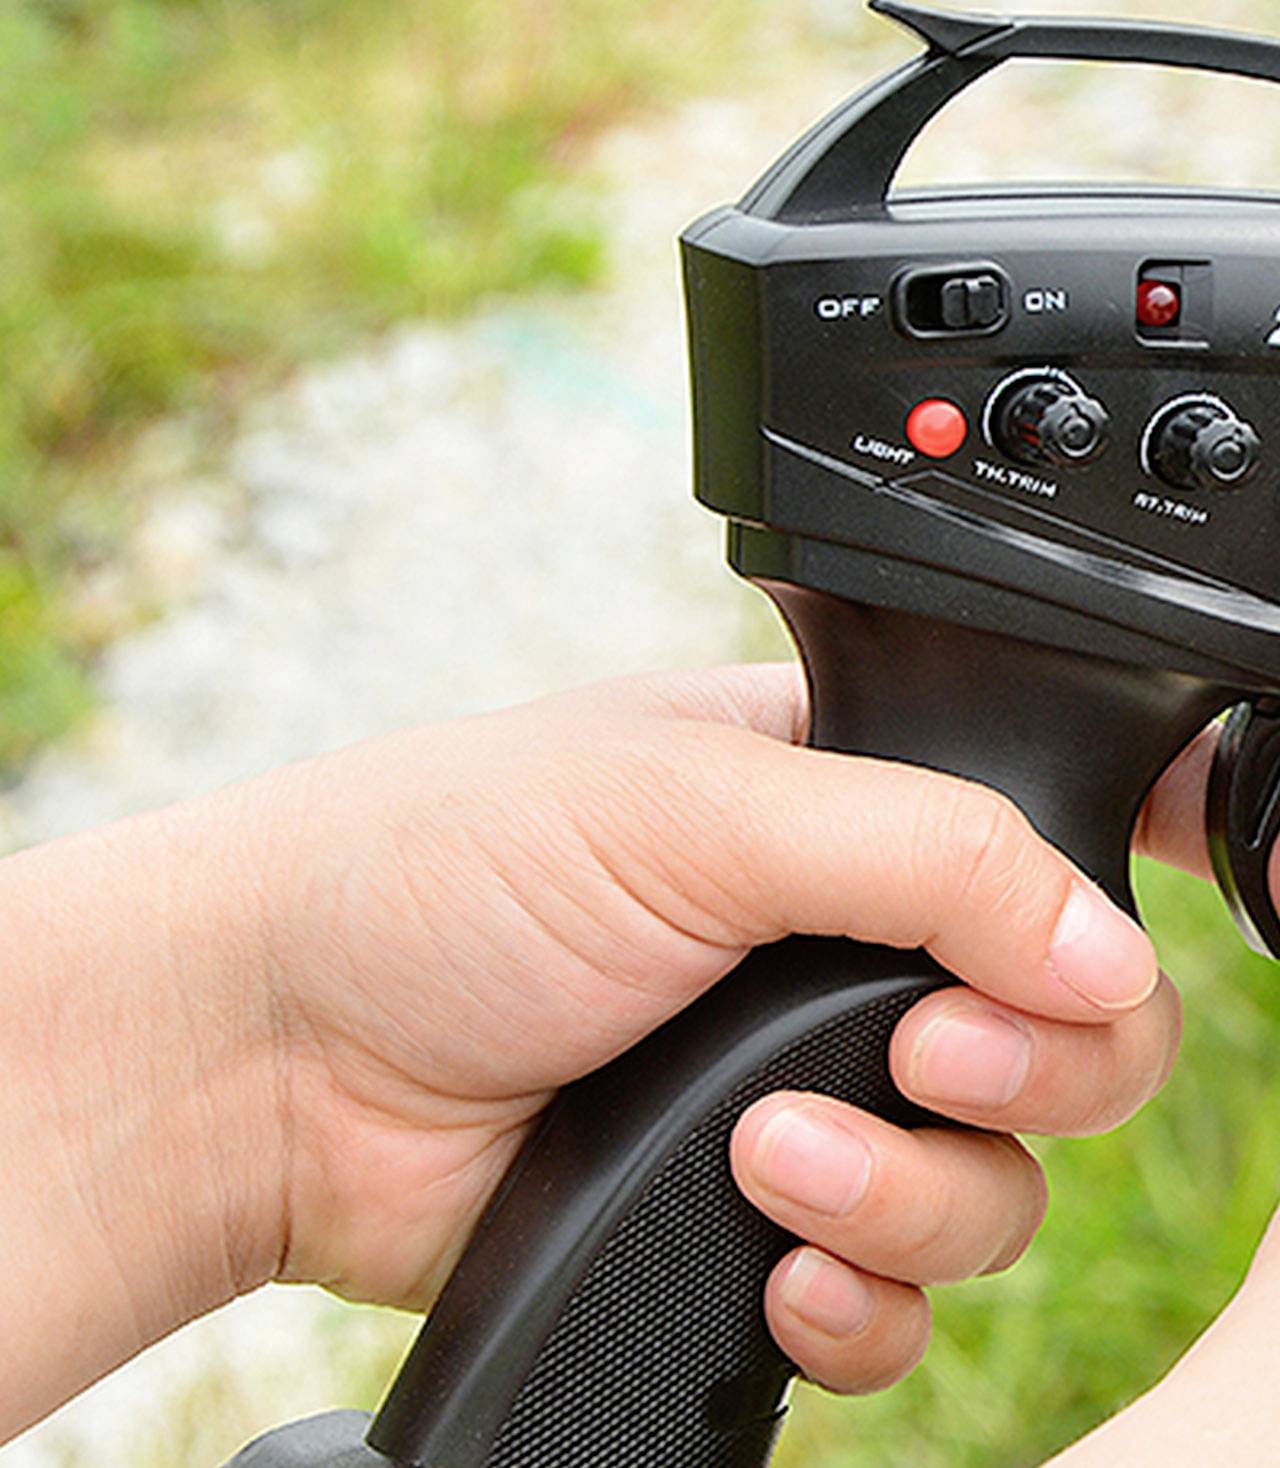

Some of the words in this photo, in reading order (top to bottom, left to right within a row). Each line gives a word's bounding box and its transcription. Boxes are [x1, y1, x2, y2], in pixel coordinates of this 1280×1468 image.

[817, 297, 880, 318] OFF
[1023, 290, 1066, 312] ON
[853, 435, 915, 464] LIGHT
